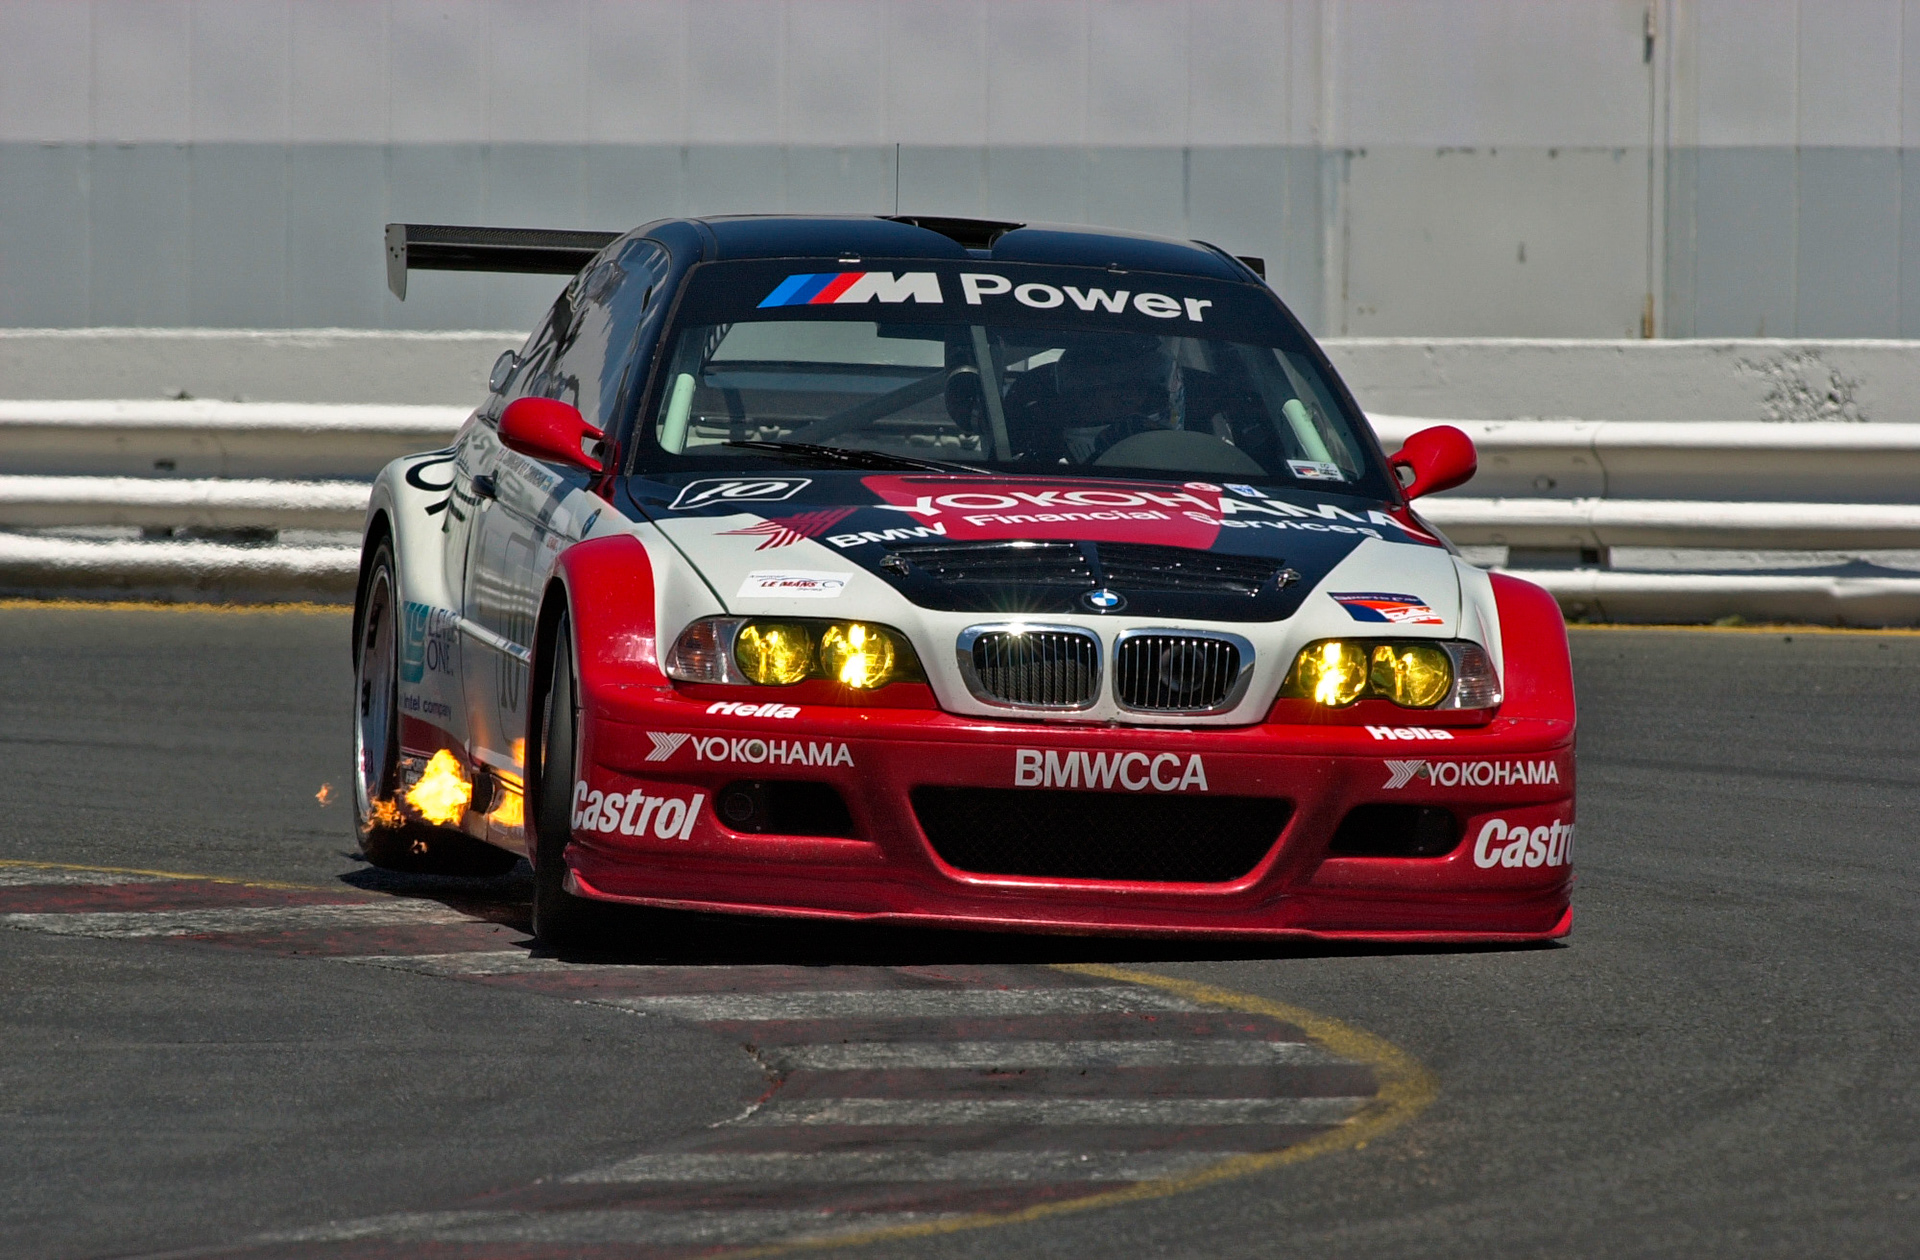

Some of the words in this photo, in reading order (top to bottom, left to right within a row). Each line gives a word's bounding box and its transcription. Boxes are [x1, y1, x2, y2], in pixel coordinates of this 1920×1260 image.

[833, 271, 944, 304] M
[960, 272, 1213, 323] Power
[685, 480, 790, 505] 10
[826, 521, 947, 548] BMW
[962, 509, 1172, 527] Financial
[1182, 510, 1383, 540] Services
[872, 490, 1438, 541] YOKOHAMA
[706, 701, 802, 719] Hella
[1364, 725, 1455, 741] Hella
[690, 736, 855, 768] YOKOHAMA
[1014, 748, 1209, 792] BMWCCA
[1426, 760, 1560, 787] YOKOHAMA
[570, 779, 706, 841] Castrol
